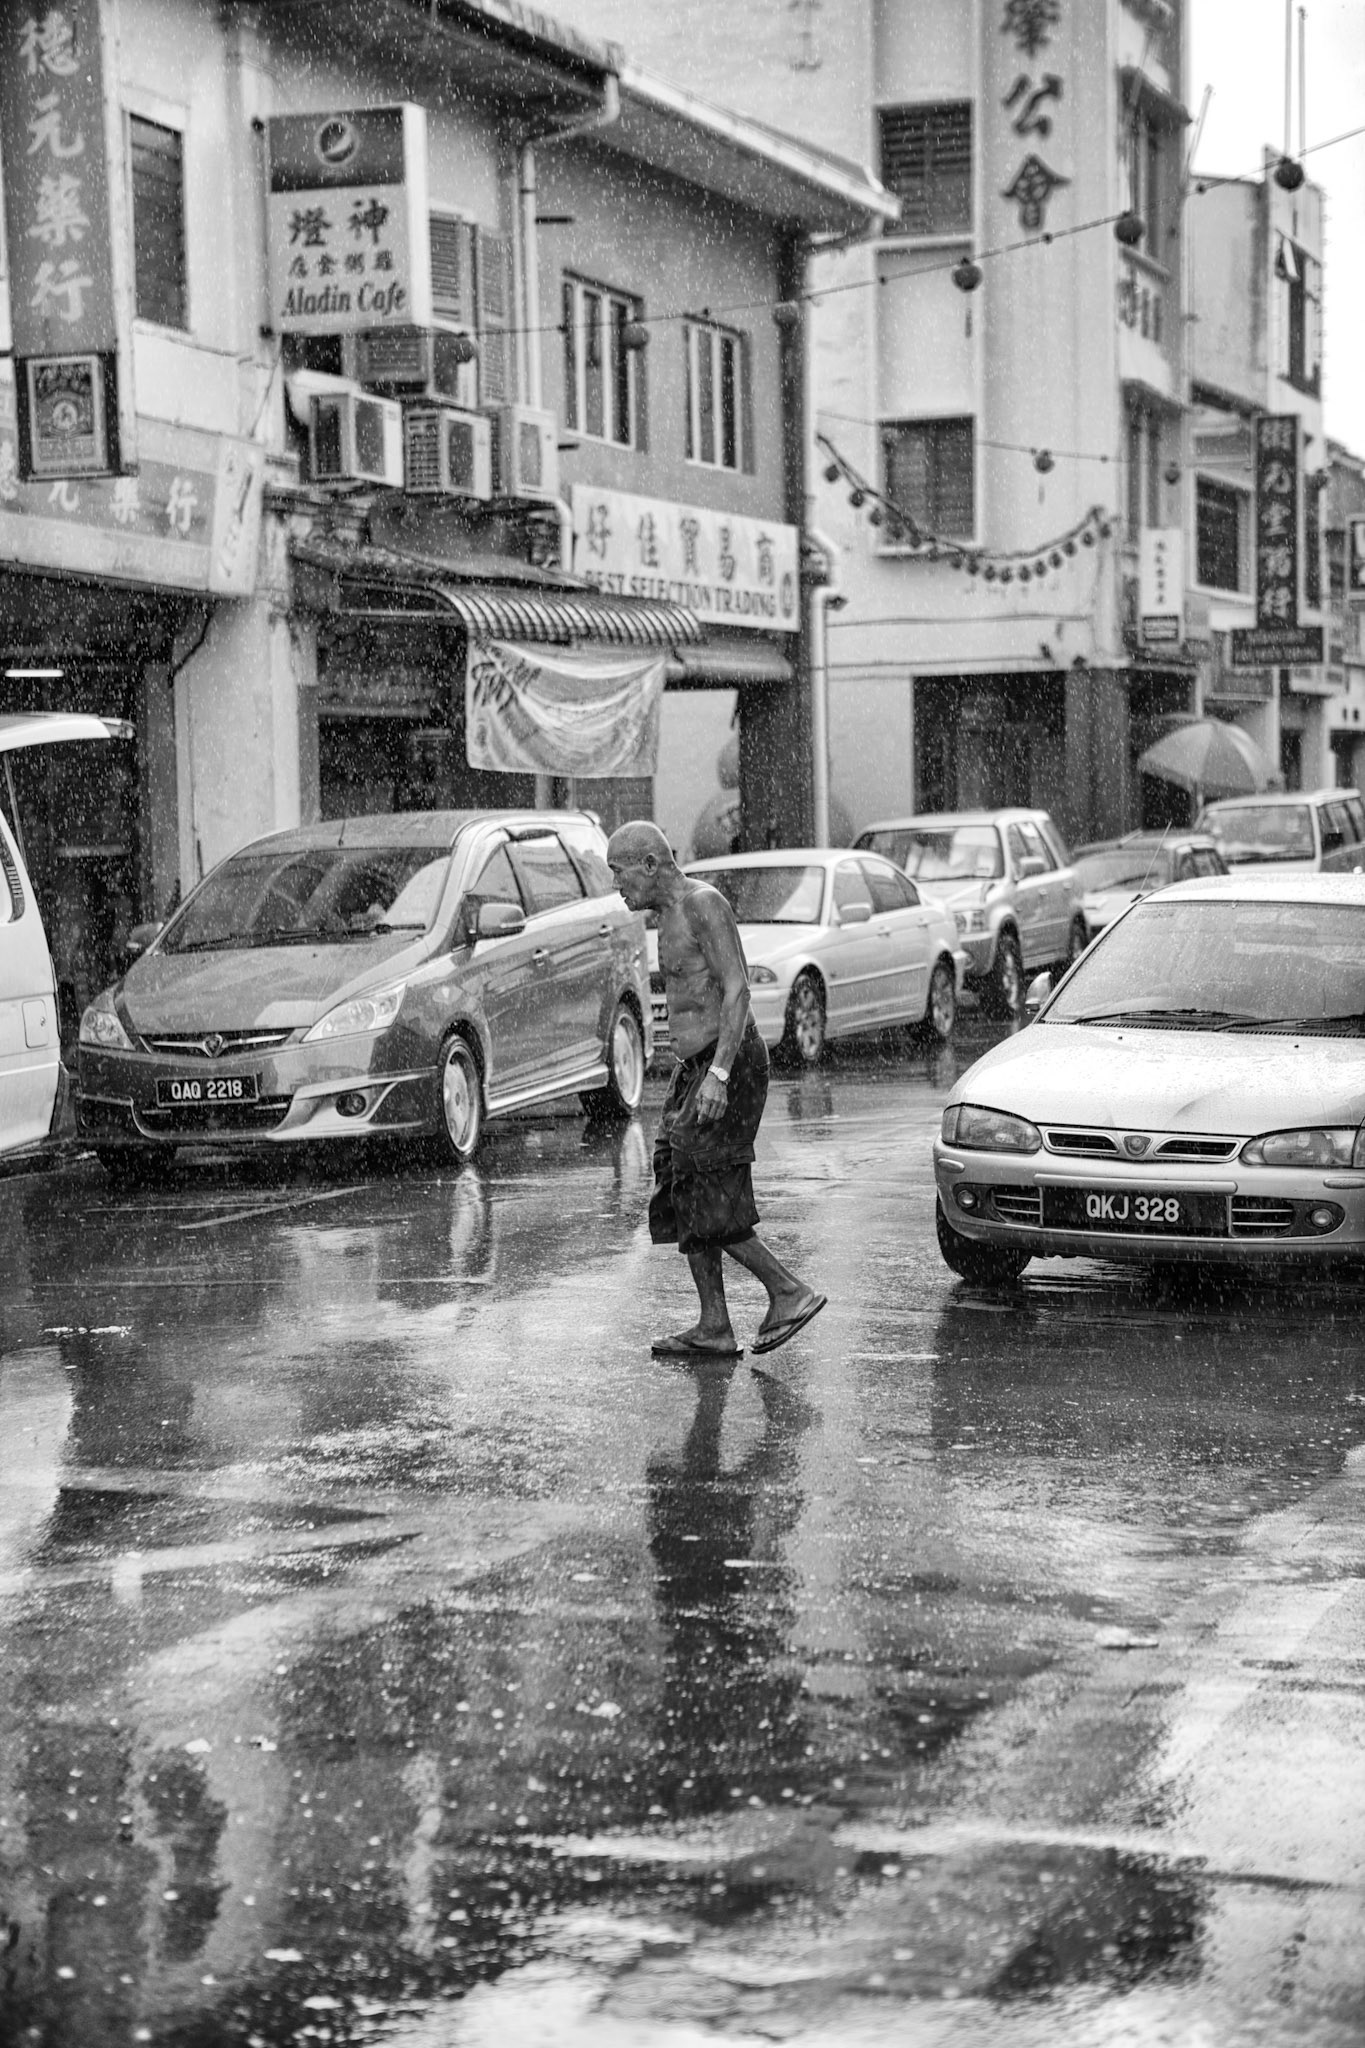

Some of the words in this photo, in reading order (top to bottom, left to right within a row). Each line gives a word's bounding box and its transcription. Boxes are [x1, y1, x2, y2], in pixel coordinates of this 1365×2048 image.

[281, 285, 351, 317] Aladin
[357, 281, 406, 315] Cafe
[714, 586, 776, 618] TRADING
[171, 1081, 201, 1100] QAQ
[206, 1079, 243, 1099] 2218
[1086, 1194, 1130, 1220] QKJ
[1134, 1197, 1180, 1223] 328
